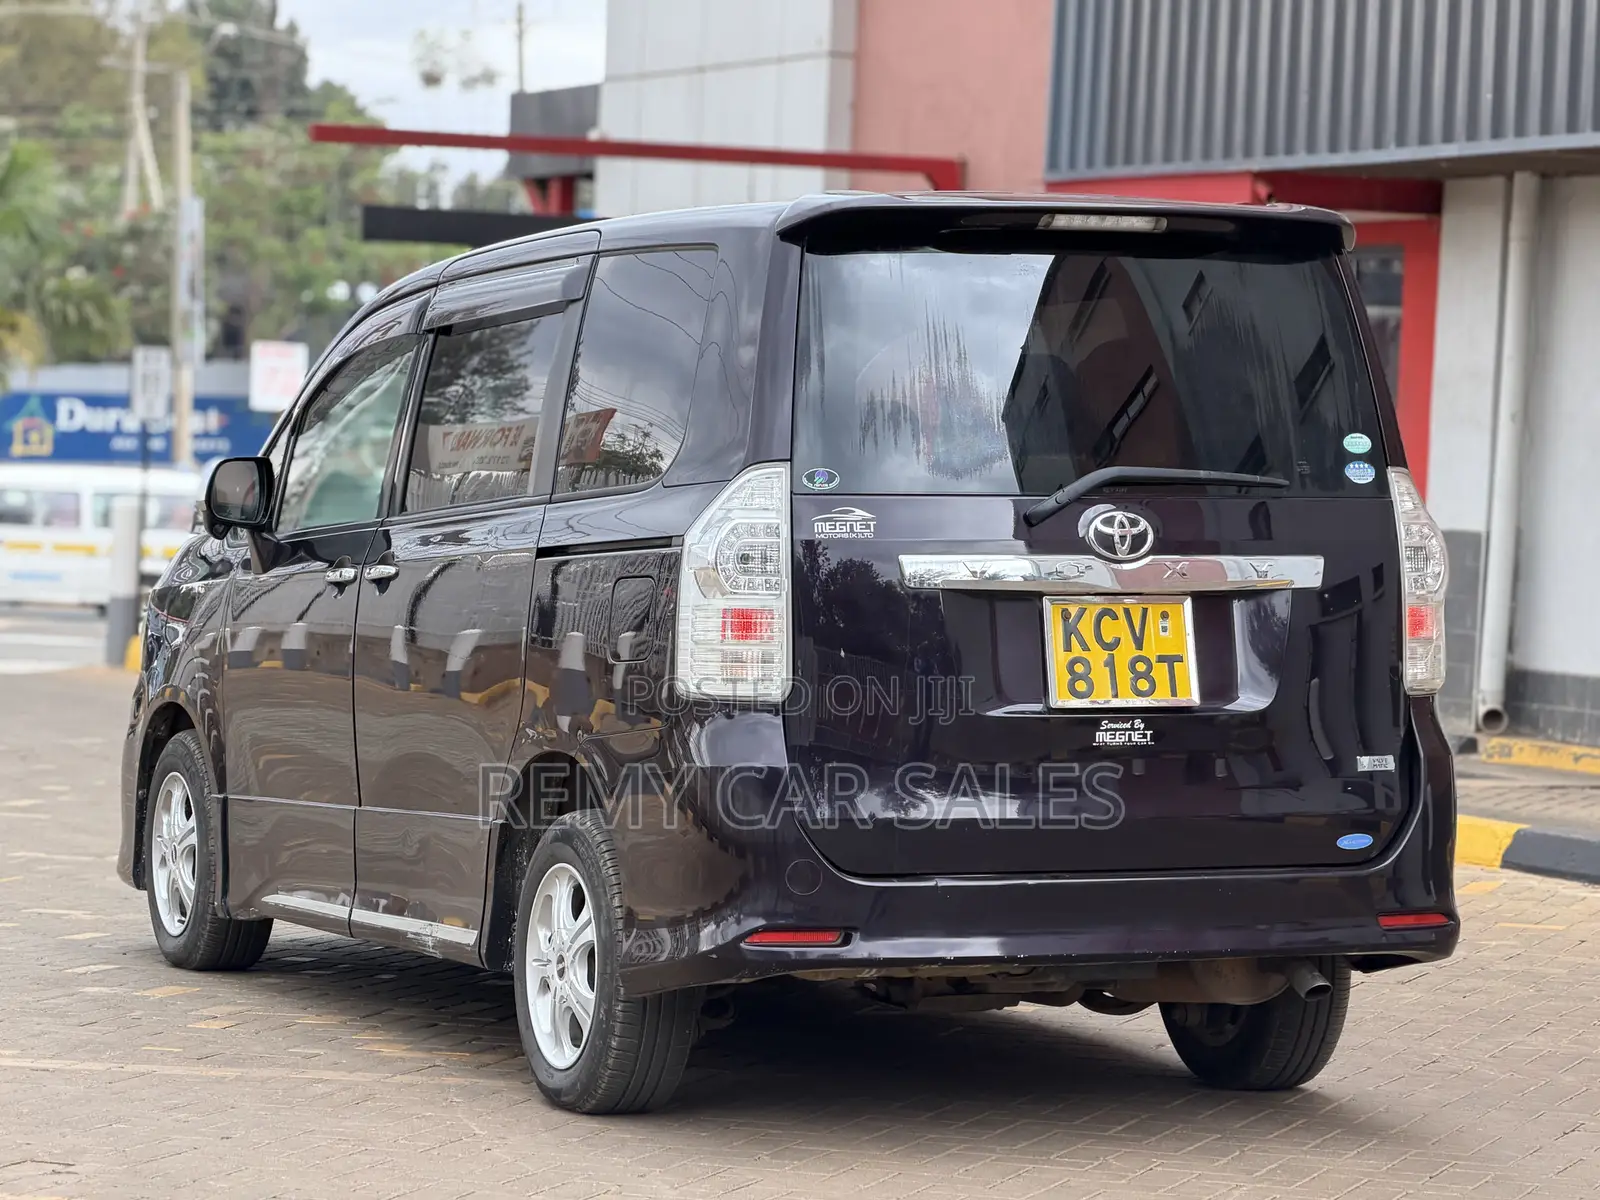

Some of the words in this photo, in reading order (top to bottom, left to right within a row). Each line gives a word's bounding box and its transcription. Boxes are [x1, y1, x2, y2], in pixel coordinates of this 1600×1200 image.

[814, 521, 877, 533] MEGNET
[960, 559, 1275, 581] VOXY
[1060, 606, 1148, 653] KCV
[1065, 653, 1184, 700] 818T
[1099, 719, 1133, 730] Serviced
[1133, 718, 1145, 731] By
[1095, 730, 1154, 742] MEGNET
